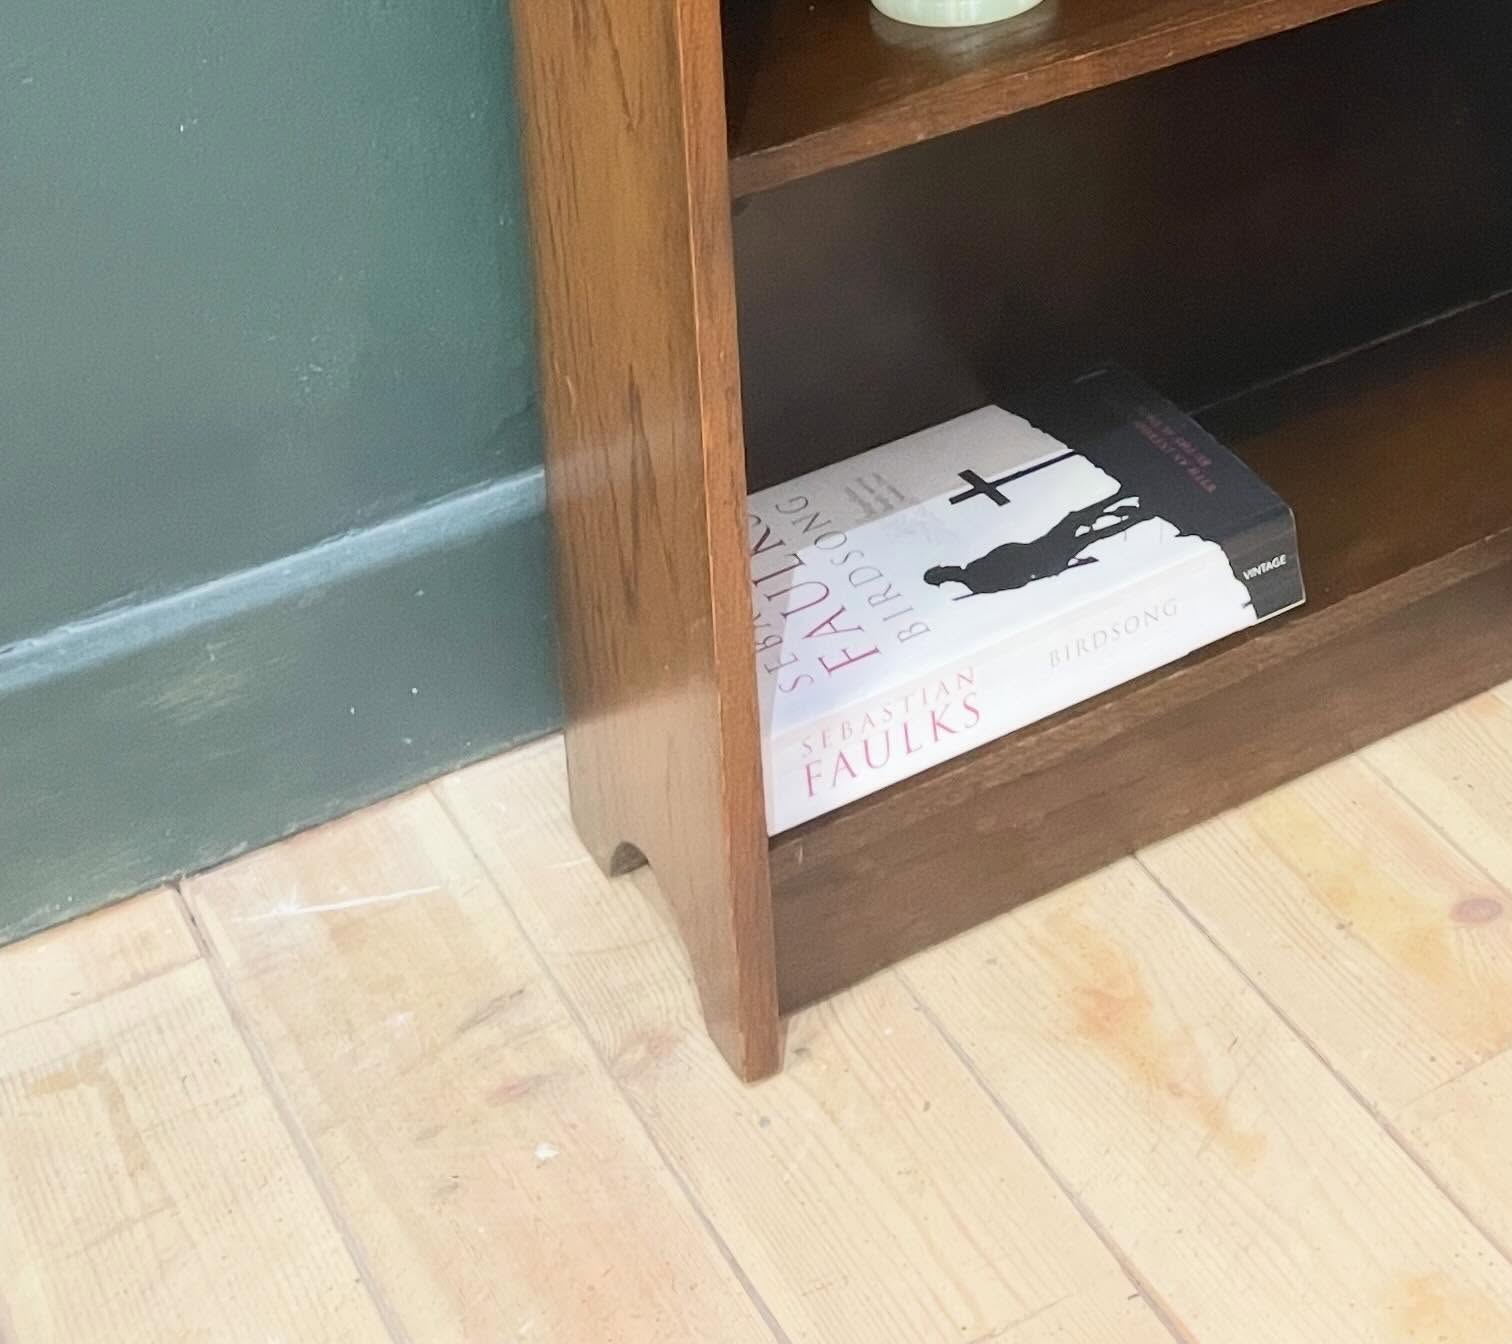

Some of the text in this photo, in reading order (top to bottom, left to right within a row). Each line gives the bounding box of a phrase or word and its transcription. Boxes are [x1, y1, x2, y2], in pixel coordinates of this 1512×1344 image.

[776, 495, 931, 643] BIRDSONG
[1242, 553, 1288, 581] VINTAGE
[1048, 597, 1181, 671] BIRDSONG
[800, 664, 978, 759] SEBASTIAN
[802, 690, 983, 799] FAULKS
